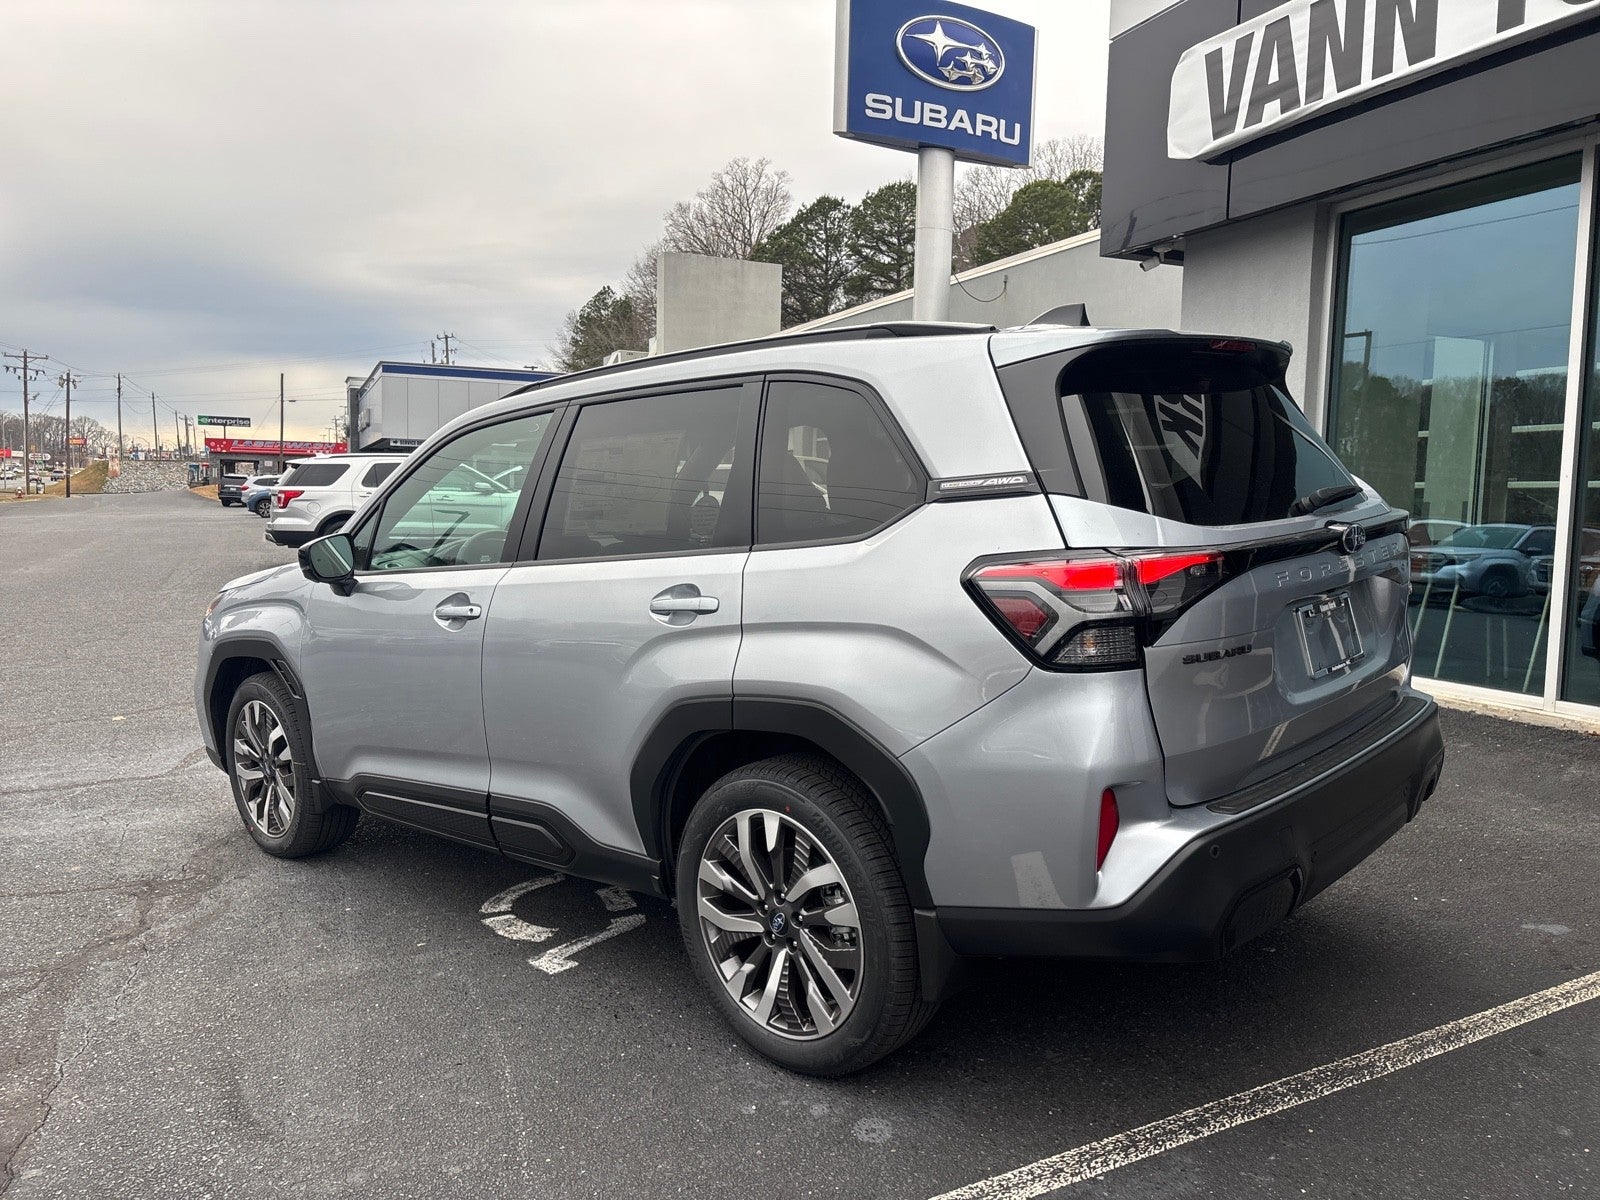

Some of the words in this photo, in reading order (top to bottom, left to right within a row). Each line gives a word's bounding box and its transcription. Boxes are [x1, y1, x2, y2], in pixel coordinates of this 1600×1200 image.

[1204, 0, 1439, 141] VANN
[865, 93, 1021, 146] SUBARU
[199, 416, 250, 426] enterprise
[983, 476, 1024, 486] AWD
[1275, 542, 1402, 588] FORESTER
[1182, 643, 1253, 665] SUBARU
